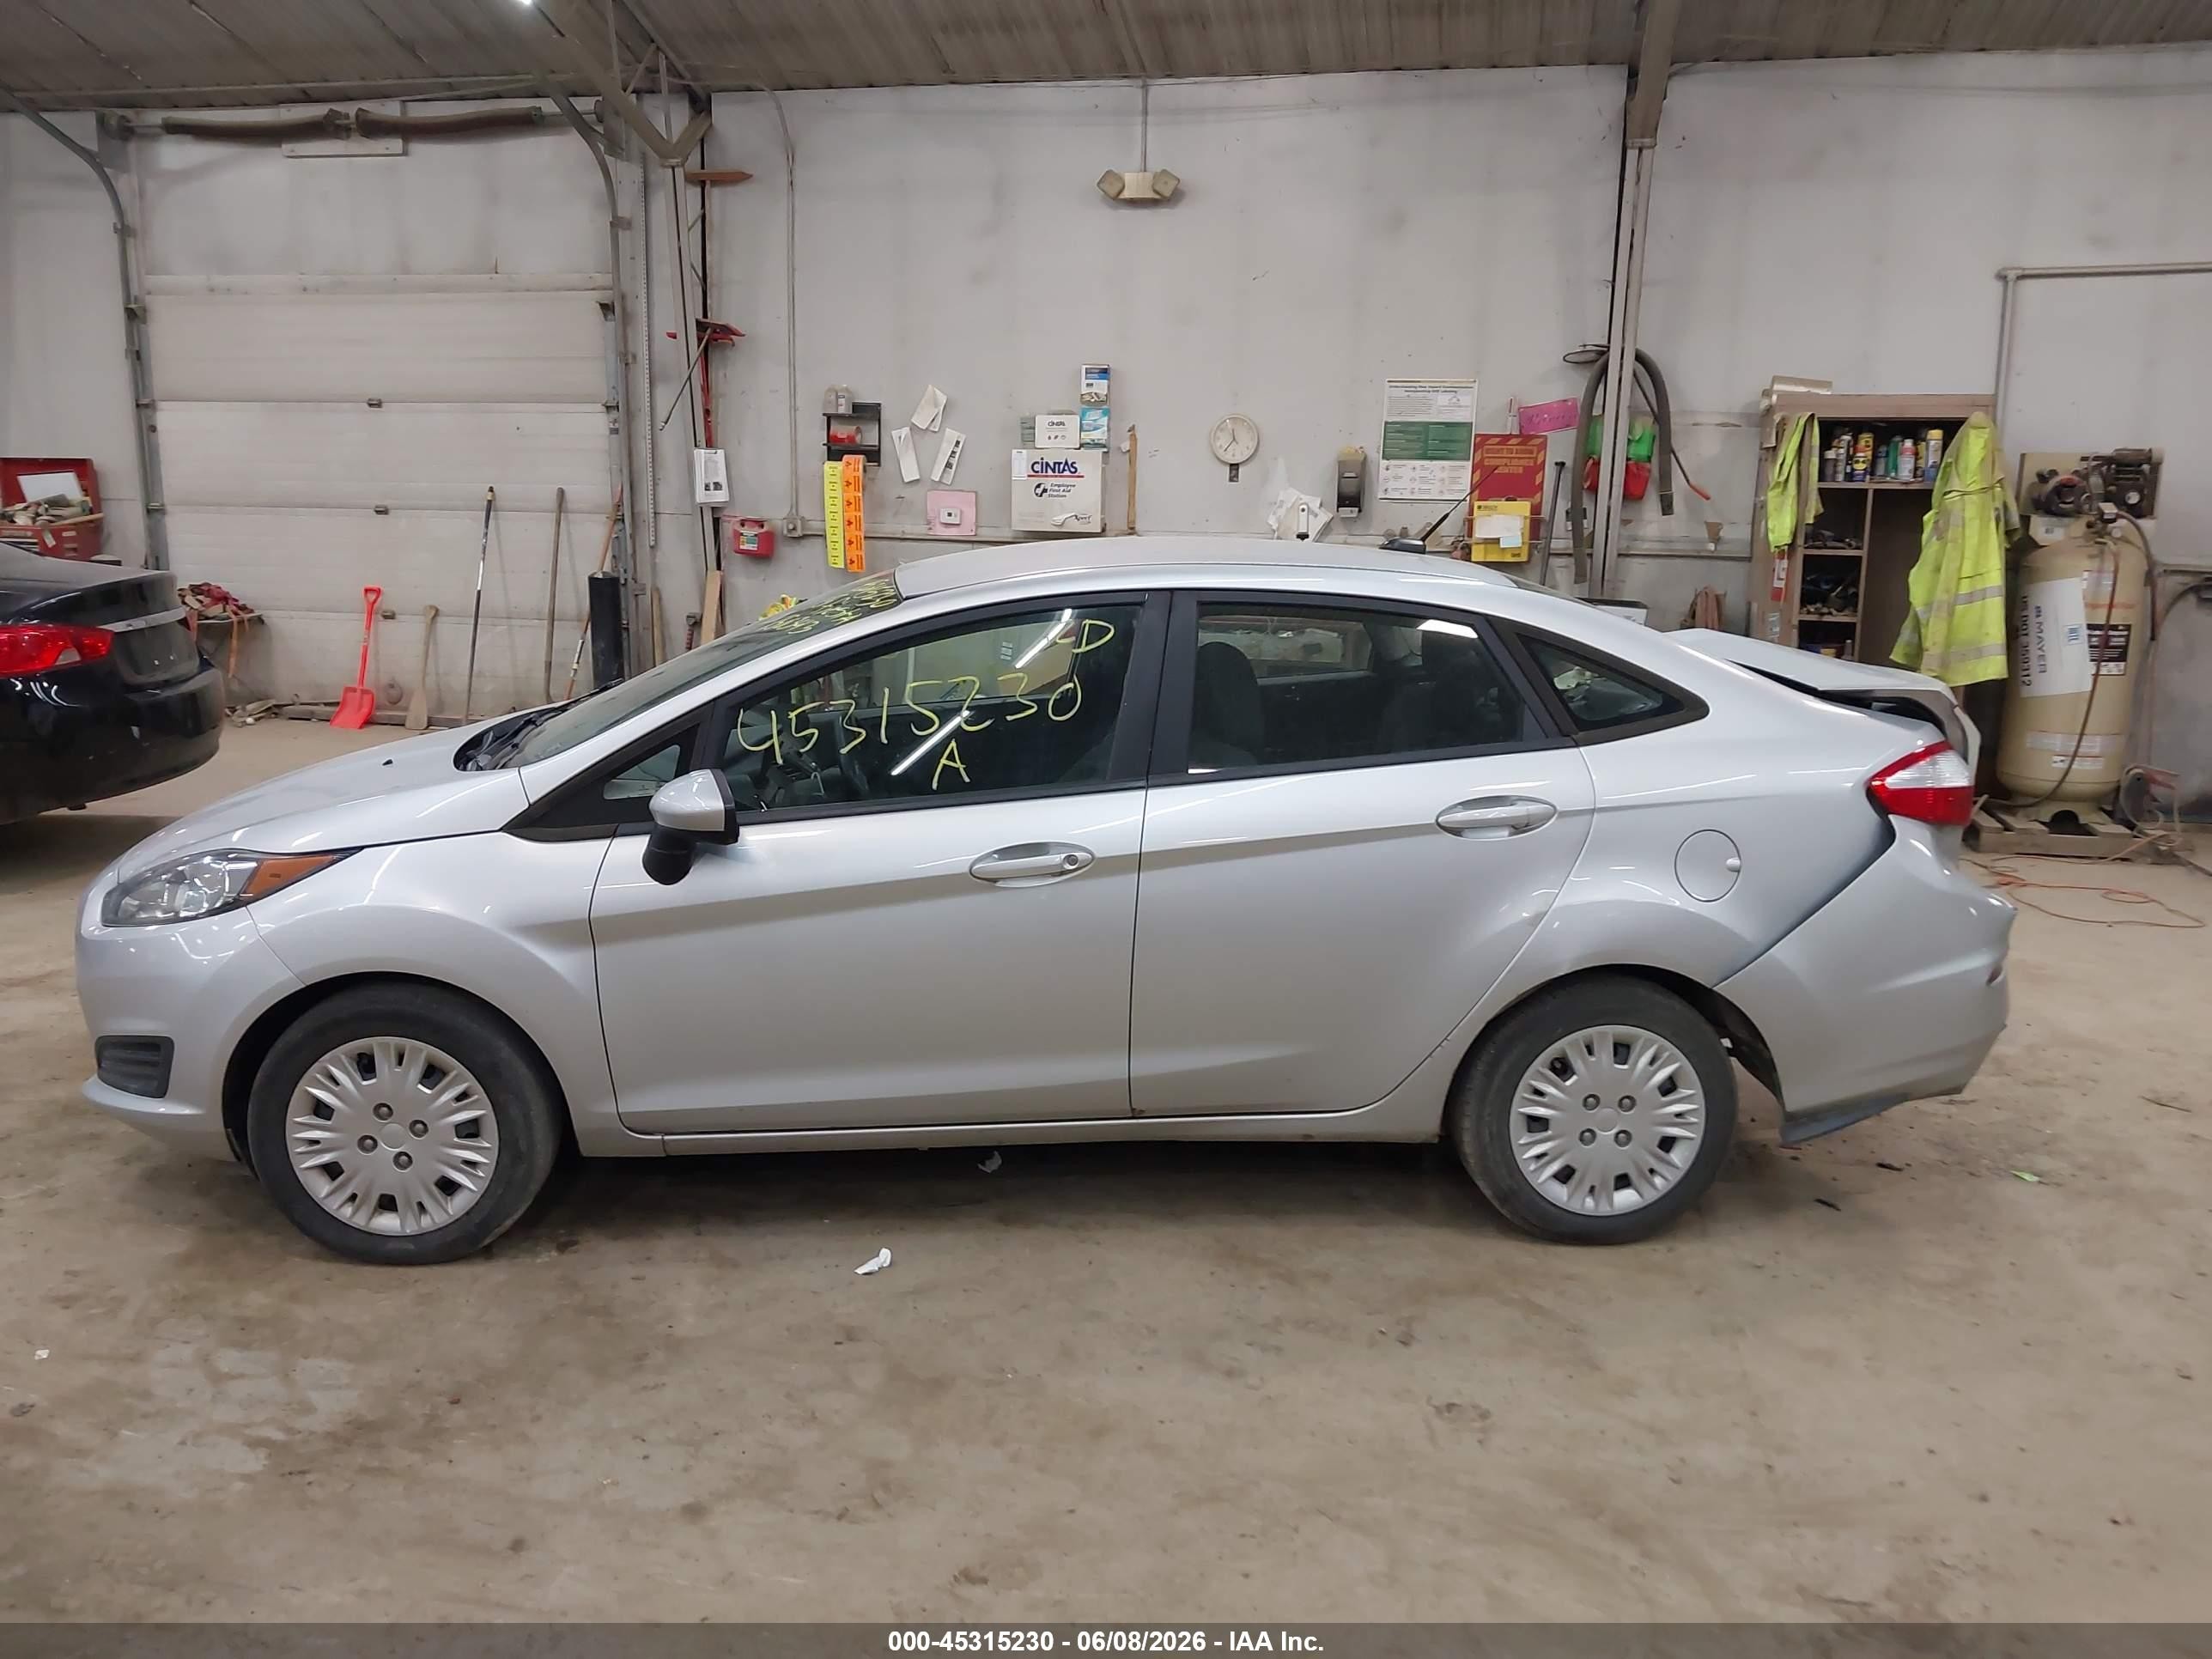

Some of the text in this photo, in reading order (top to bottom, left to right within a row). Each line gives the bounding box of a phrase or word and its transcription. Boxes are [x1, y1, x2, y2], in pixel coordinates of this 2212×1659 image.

[1030, 457, 1079, 474] CINTAS
[737, 672, 1083, 766] 45315230
[932, 738, 972, 791] A
